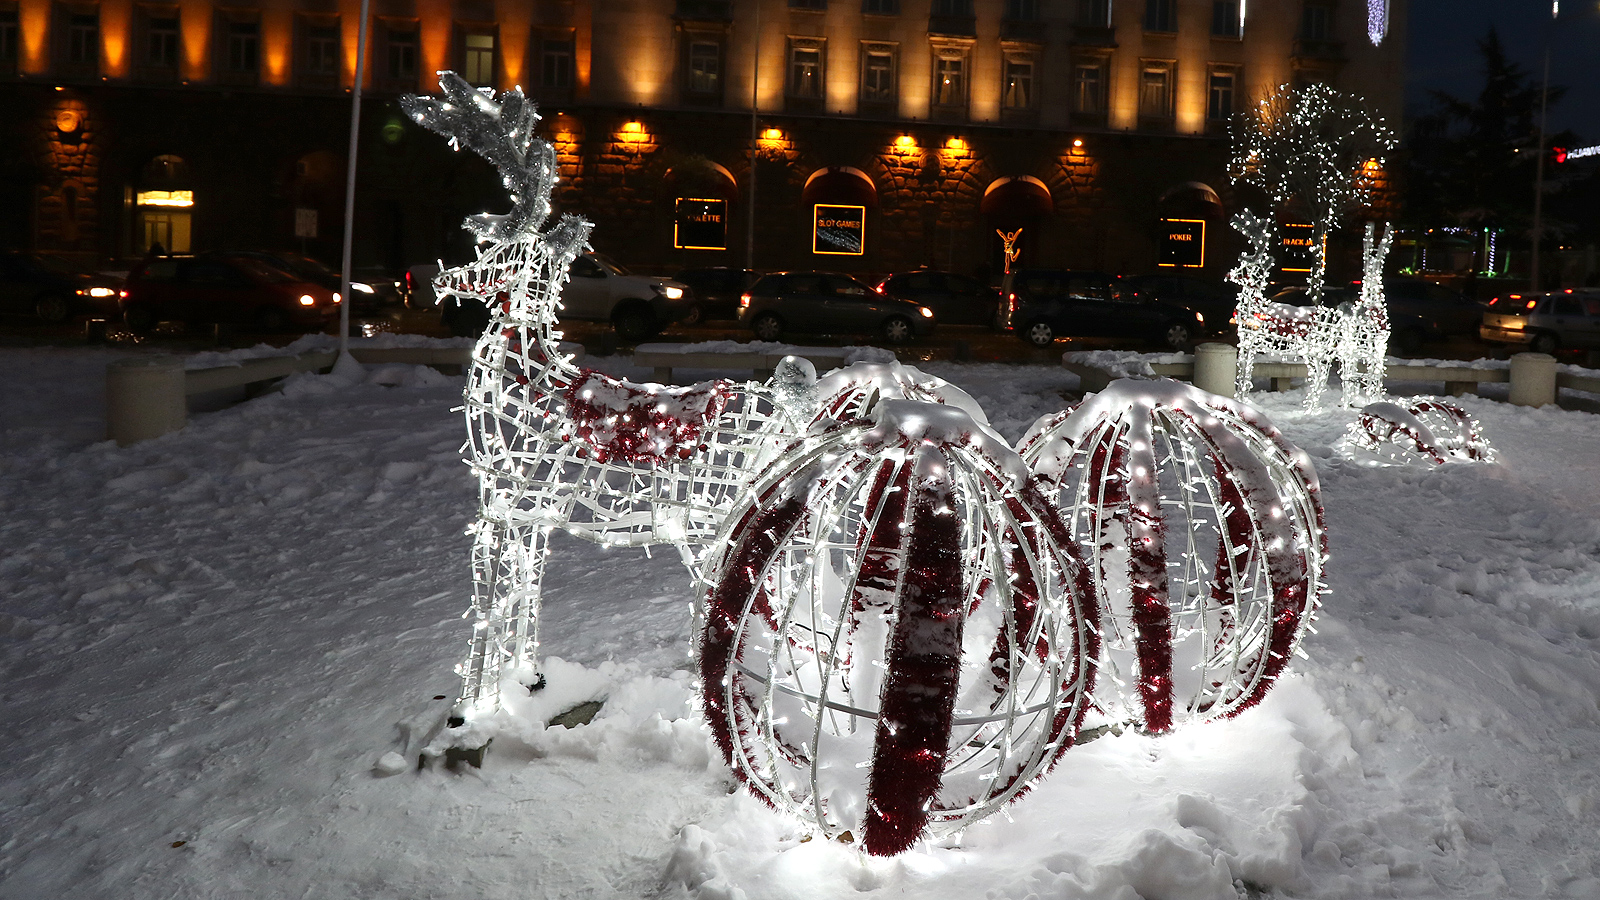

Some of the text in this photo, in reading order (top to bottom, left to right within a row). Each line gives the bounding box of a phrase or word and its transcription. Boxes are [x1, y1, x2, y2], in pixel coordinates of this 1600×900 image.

[818, 219, 861, 228] SLOT GAMES
[1169, 233, 1192, 241] POKER
